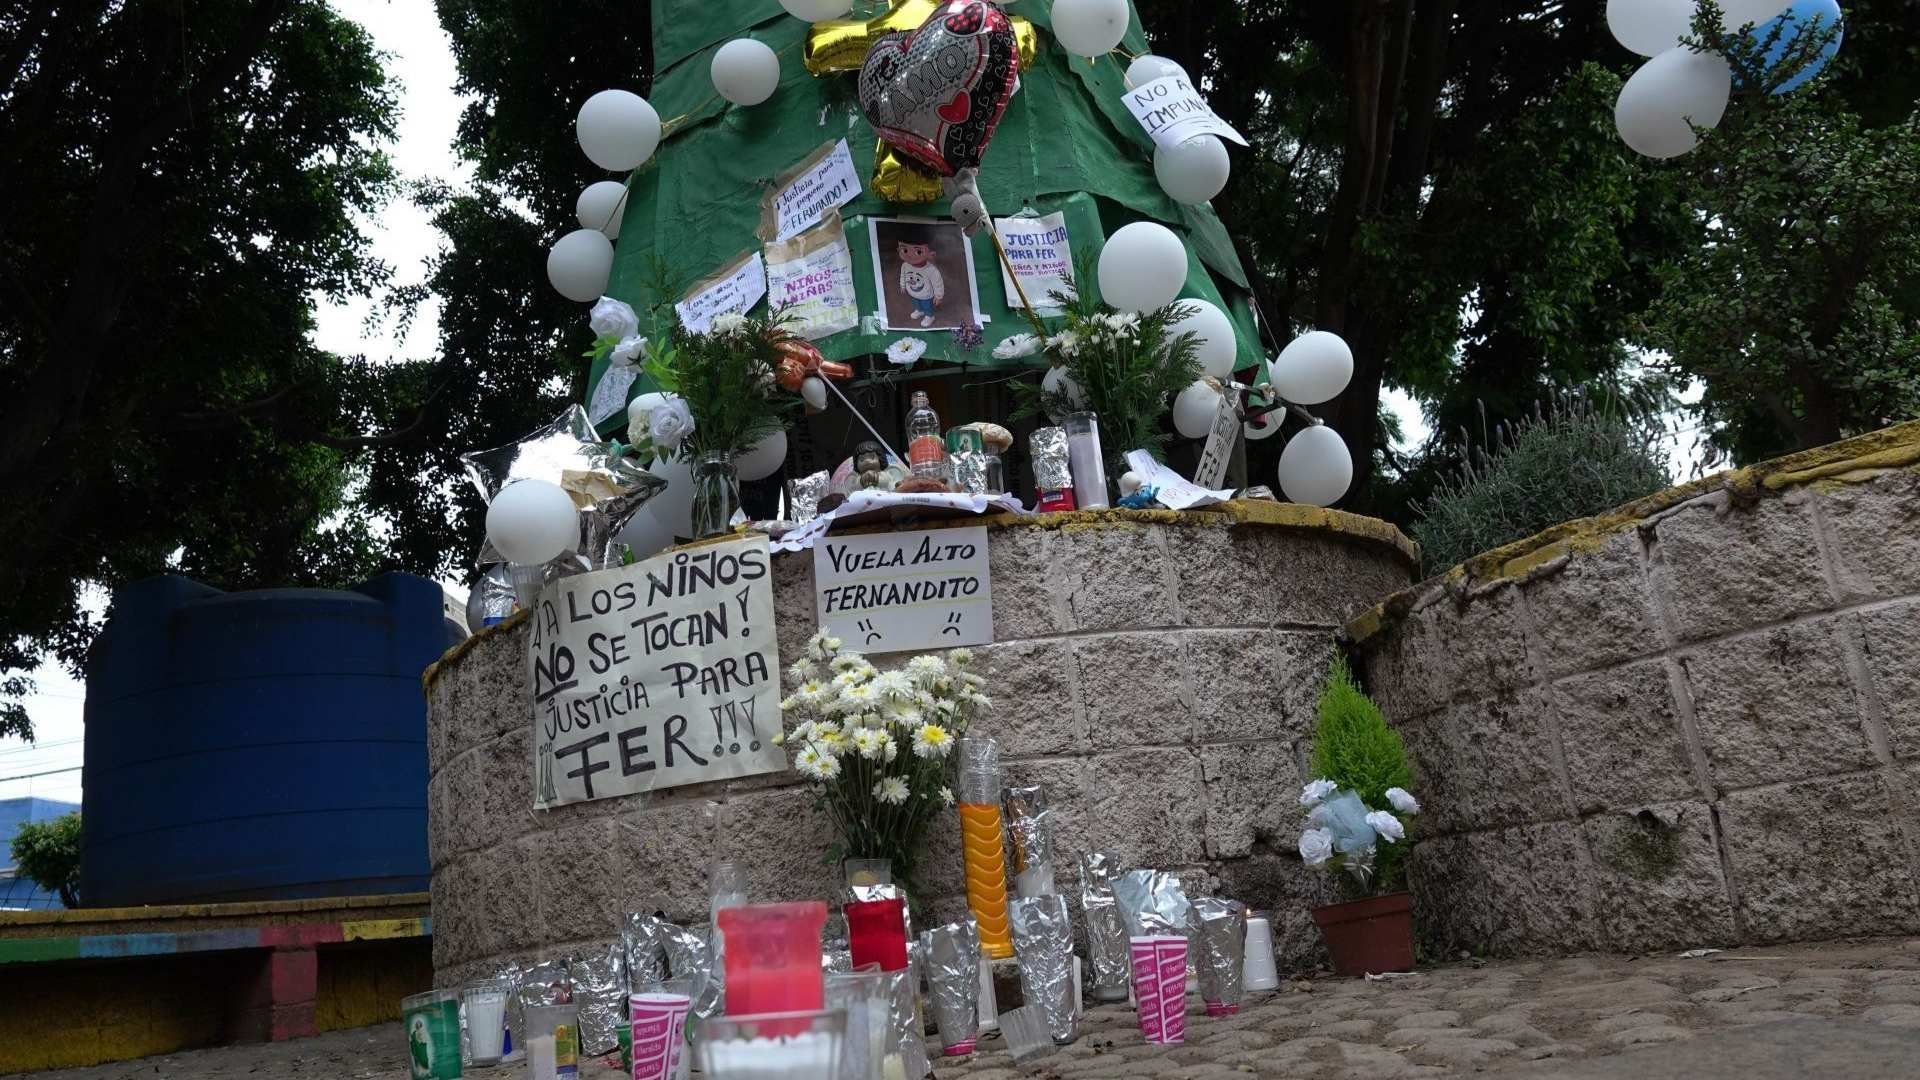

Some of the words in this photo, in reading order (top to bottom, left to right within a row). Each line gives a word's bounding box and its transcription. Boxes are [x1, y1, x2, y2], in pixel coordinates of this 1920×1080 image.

[890, 44, 968, 125] AMO
[1134, 84, 1168, 108] NO
[818, 160, 834, 180] para
[1004, 248, 1034, 260] PARA
[1035, 248, 1057, 260] FER
[1006, 226, 1068, 246] JUSTICIA
[826, 543, 905, 574] VUELA
[911, 535, 976, 566] ALTO
[567, 582, 637, 623] LOS
[823, 576, 980, 614] FERNANDITO
[534, 642, 576, 700] NO
[587, 632, 631, 675] SE
[660, 651, 769, 699] PARA
